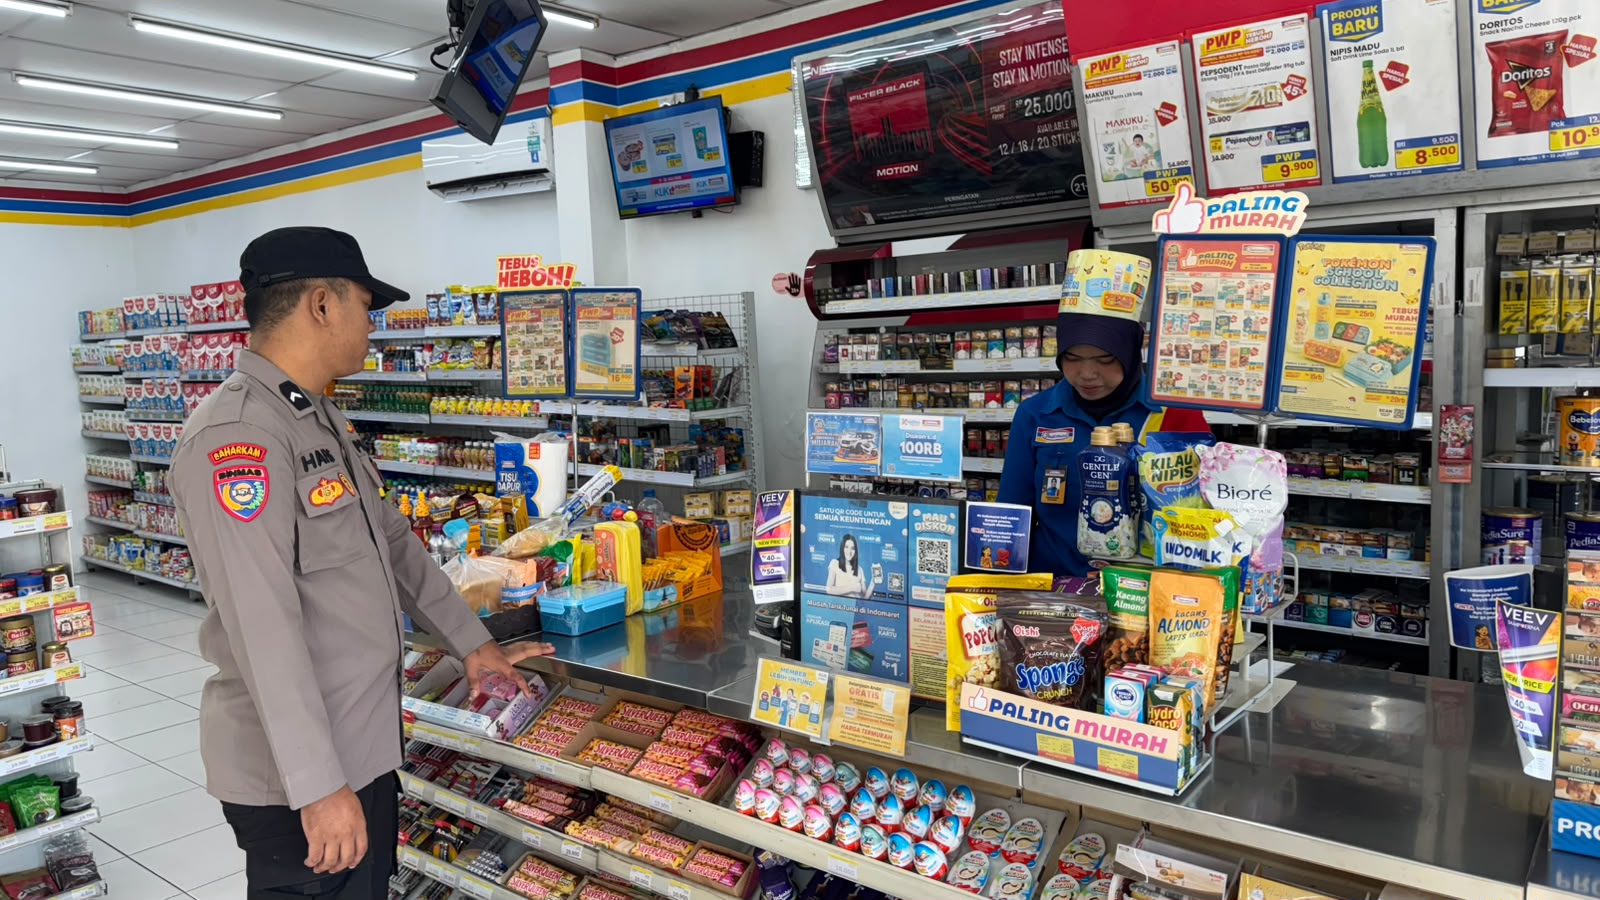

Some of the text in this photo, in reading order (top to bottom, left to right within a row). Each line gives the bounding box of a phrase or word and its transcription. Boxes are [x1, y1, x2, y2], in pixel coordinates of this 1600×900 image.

[1330, 5, 1378, 21] PRODUK
[1332, 16, 1379, 36] BARU
[1480, 16, 1524, 30] DORITOS
[1480, 14, 1582, 36] Snack Nacho Cheese 120g pck
[1206, 30, 1242, 51] PWP
[1570, 42, 1592, 52] HARGA
[999, 37, 1069, 67] STAY INTENSE
[1270, 46, 1290, 54] 2.000
[1330, 42, 1380, 56] NIPIS MADU
[1343, 52, 1358, 60] Drink
[1374, 48, 1390, 56] Soda
[1565, 48, 1590, 60] SPESIAL
[1090, 54, 1122, 74] PWP
[1200, 60, 1270, 78] PEPSODENT Pasta Gigi
[1201, 74, 1218, 82] Strong
[1246, 68, 1256, 76] Best
[1258, 64, 1282, 74] Defender
[1295, 60, 1305, 68] tub
[992, 71, 1016, 89] STAY
[1016, 70, 1030, 84] IN
[1030, 63, 1072, 82] MOTION
[1382, 72, 1404, 84] SPESIAL
[1387, 67, 1405, 78] HARGA
[1502, 66, 1552, 84] Doritos
[849, 78, 921, 102] FILTER BLACK
[1085, 89, 1115, 100] MAKUKU
[1284, 86, 1305, 96] 45%
[1036, 120, 1078, 135] AVAILABLE IN
[1106, 116, 1144, 128] MAKUKU
[1225, 134, 1262, 145] Pepsodent
[1396, 136, 1456, 148] Btl 9.500
[1562, 126, 1600, 146] 10.9
[998, 144, 1009, 156] 12
[1018, 140, 1029, 153] 18
[1037, 138, 1050, 150] 20
[1275, 152, 1302, 162] PWP
[1415, 146, 1456, 165] 8.500
[876, 164, 919, 178] MOTION
[1156, 169, 1178, 178] PWP
[1280, 161, 1314, 178] 9.900
[1206, 195, 1300, 216] PALING
[1210, 212, 1298, 231] MURAH
[1198, 252, 1236, 260] PALING
[1199, 258, 1234, 268] MURAH
[1322, 256, 1392, 270] POKÉMON
[498, 257, 538, 270] TEBUS
[498, 266, 574, 288] HEBOH!
[1326, 268, 1382, 280] SCHOOL
[1314, 275, 1398, 292] COLLECTION
[1391, 306, 1418, 315] TEBUS
[1384, 314, 1418, 322] MURAH
[1570, 416, 1600, 424] Bebelov
[214, 446, 260, 461] BAHARKAM
[900, 440, 943, 456] 100RB
[1082, 462, 1120, 472] GENTLE
[1150, 454, 1193, 470] KILAU
[500, 472, 518, 482] TISU
[1090, 471, 1111, 480] GEN
[1152, 466, 1194, 482] NIPIS
[497, 482, 520, 491] DAPUR
[1218, 483, 1273, 500] Bioré
[761, 492, 785, 503] VEEV
[819, 506, 886, 518] SATU QR CODE UNTUK
[922, 512, 948, 523] MAU
[814, 512, 892, 527] SEMUA KEUNTUNGAN
[1170, 521, 1207, 532] KEMASAN
[914, 522, 956, 536] DISKON
[1170, 528, 1208, 539] EKONOMIS
[1165, 542, 1222, 564] INDOMILK
[1116, 590, 1147, 603] Kacang
[806, 600, 900, 619] Mudah Tarik Tunai di Indomaret
[1114, 600, 1147, 612] Almond
[1175, 610, 1207, 619] kacang
[1503, 605, 1549, 626] VEEV
[1013, 624, 1040, 637] Oishi
[1158, 617, 1210, 634] ALMOND
[878, 630, 898, 639] KARTU
[964, 625, 997, 649] POPC
[1165, 633, 1187, 642] LAPIS
[1029, 650, 1058, 659] CHOCOLATE
[882, 660, 891, 669] Rp
[780, 666, 807, 678] MEMBER
[1016, 656, 1085, 694] Sponge
[770, 672, 815, 687] LEBIH UNTUNG!
[848, 687, 880, 700] GRATIS
[1036, 687, 1073, 700] CRUNCH
[622, 706, 672, 723] SILVERQUEEN
[1148, 706, 1182, 720] Hydro
[840, 724, 893, 741] HARGA TERMURAH
[988, 698, 1070, 732] PALING
[1074, 718, 1168, 754] MURAH
[664, 726, 706, 746] SILVERQUEEN
[651, 742, 693, 760] SILVERQUEEN
[640, 760, 680, 777] SILVERQUEEN
[650, 830, 688, 848] SILVERQUEEN
[640, 842, 677, 862] SILVERQUEEN
[694, 850, 732, 868] SILVERQUEEN
[524, 861, 561, 880] SILVERQUEEN
[686, 862, 723, 879] SILVERQUEEN
[510, 876, 548, 897] SILVERQUEEN
